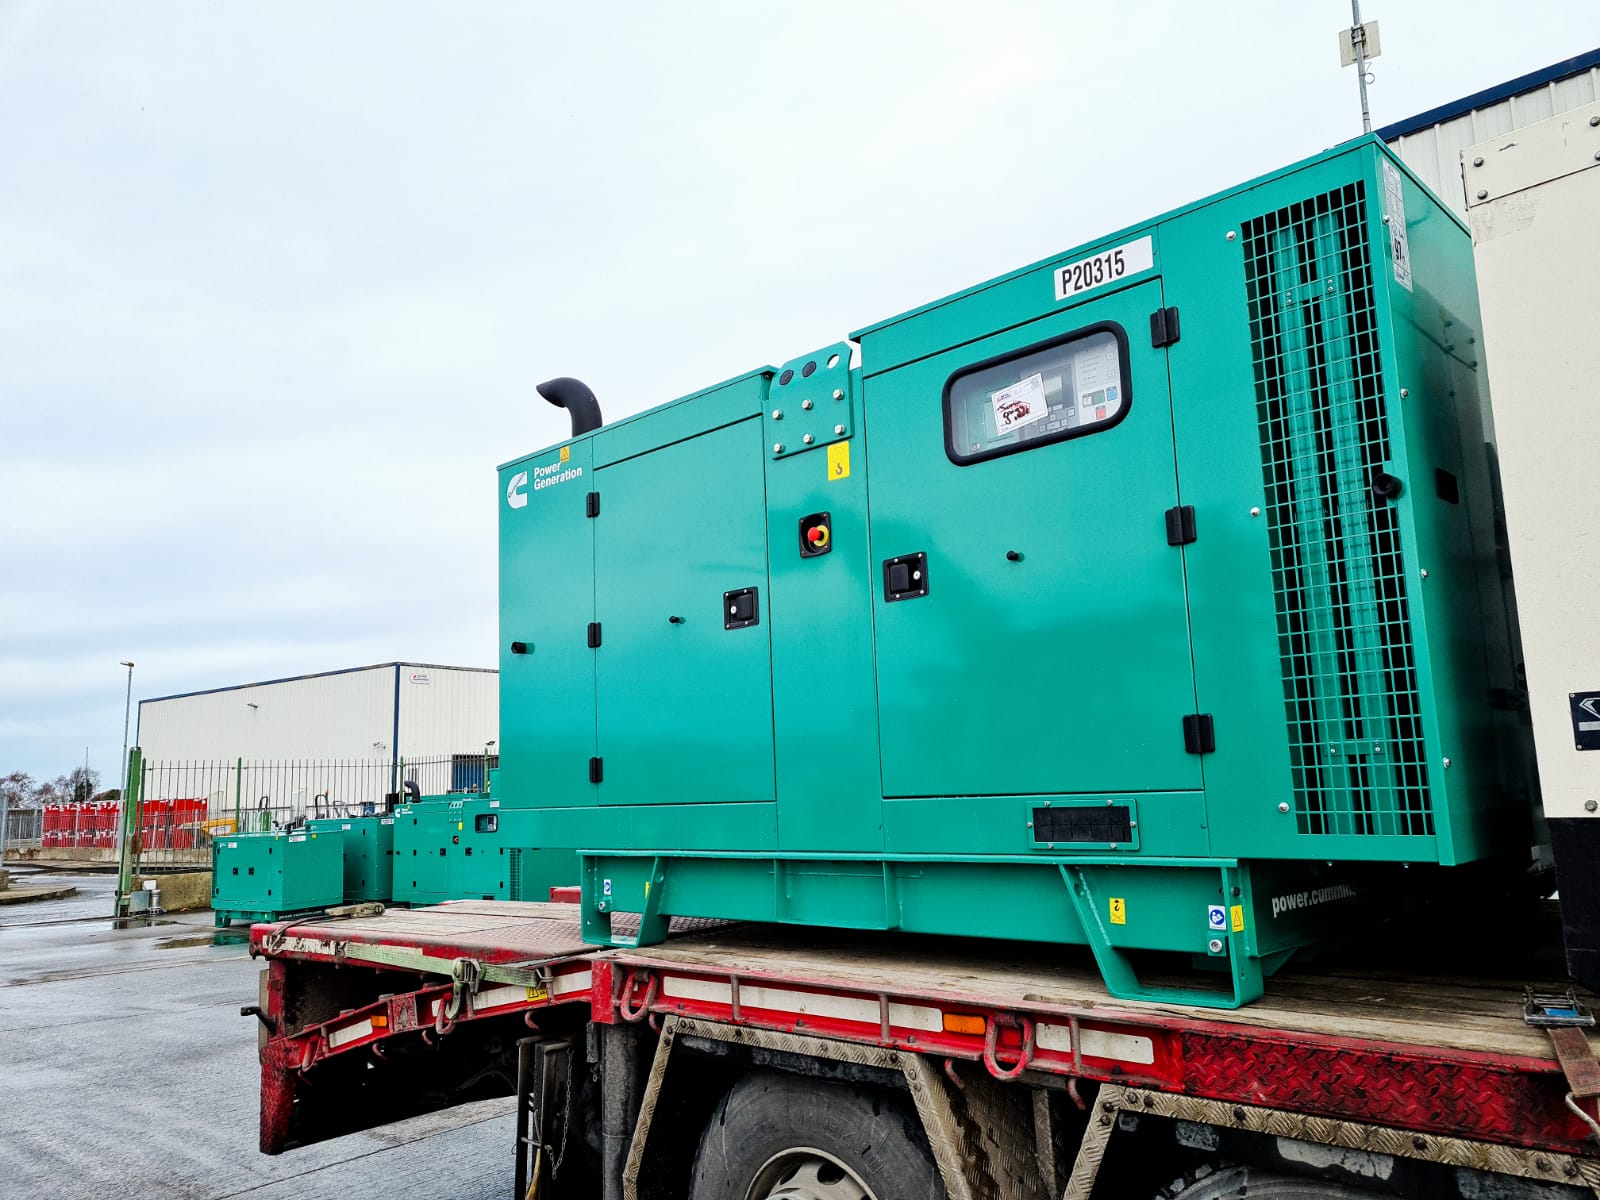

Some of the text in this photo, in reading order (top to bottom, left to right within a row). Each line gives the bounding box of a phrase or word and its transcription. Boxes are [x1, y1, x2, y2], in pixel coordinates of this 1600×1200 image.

[1062, 249, 1125, 295] P20315
[534, 462, 561, 479] Power
[534, 467, 582, 490] Generation
